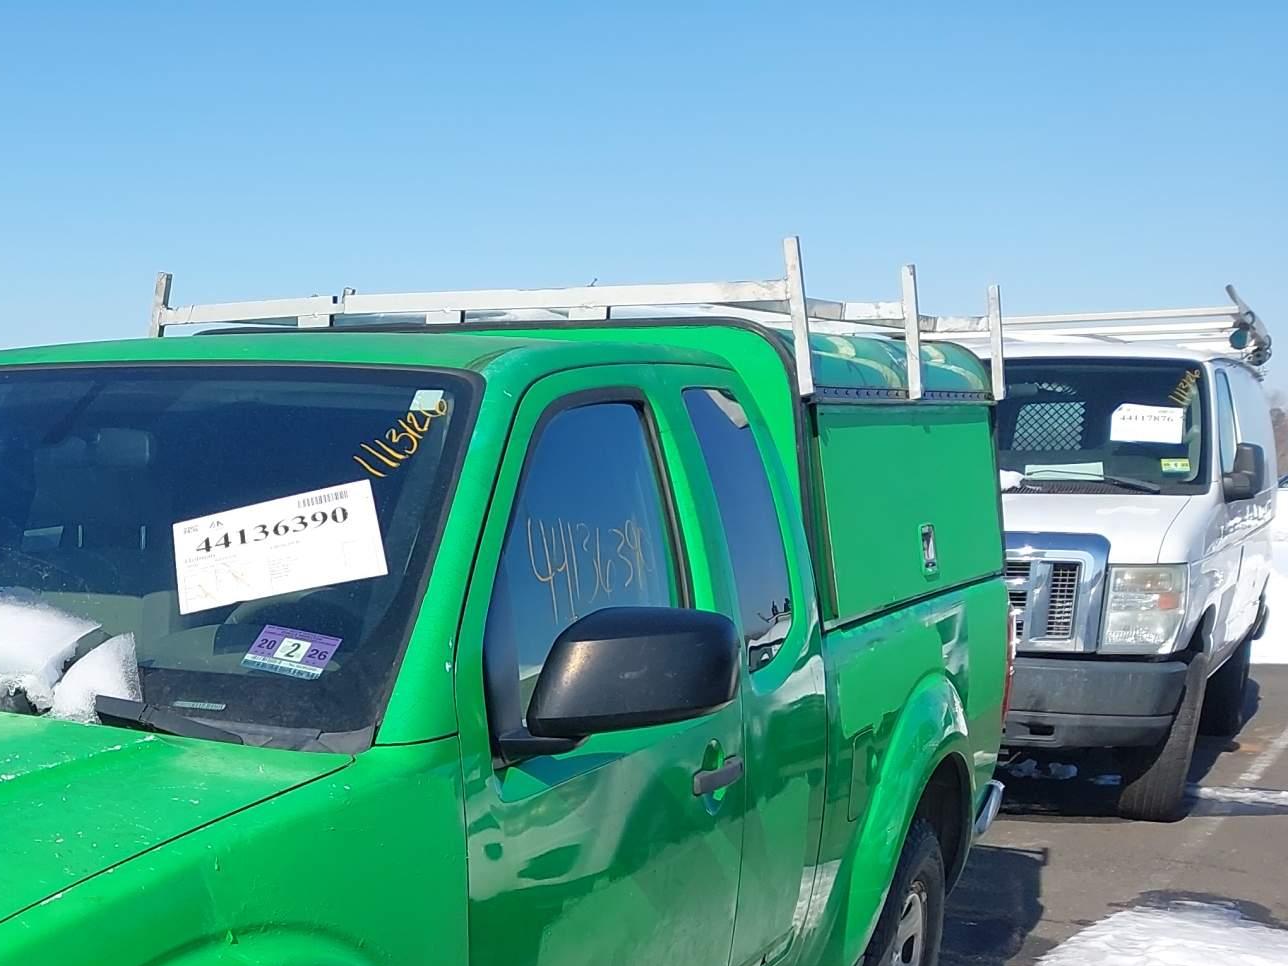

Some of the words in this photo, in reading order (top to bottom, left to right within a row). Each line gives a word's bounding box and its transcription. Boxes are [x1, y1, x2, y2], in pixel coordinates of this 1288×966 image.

[196, 506, 349, 553] 44136390
[257, 638, 277, 650] 20
[285, 642, 301, 658] 2
[308, 648, 329, 661] 26
